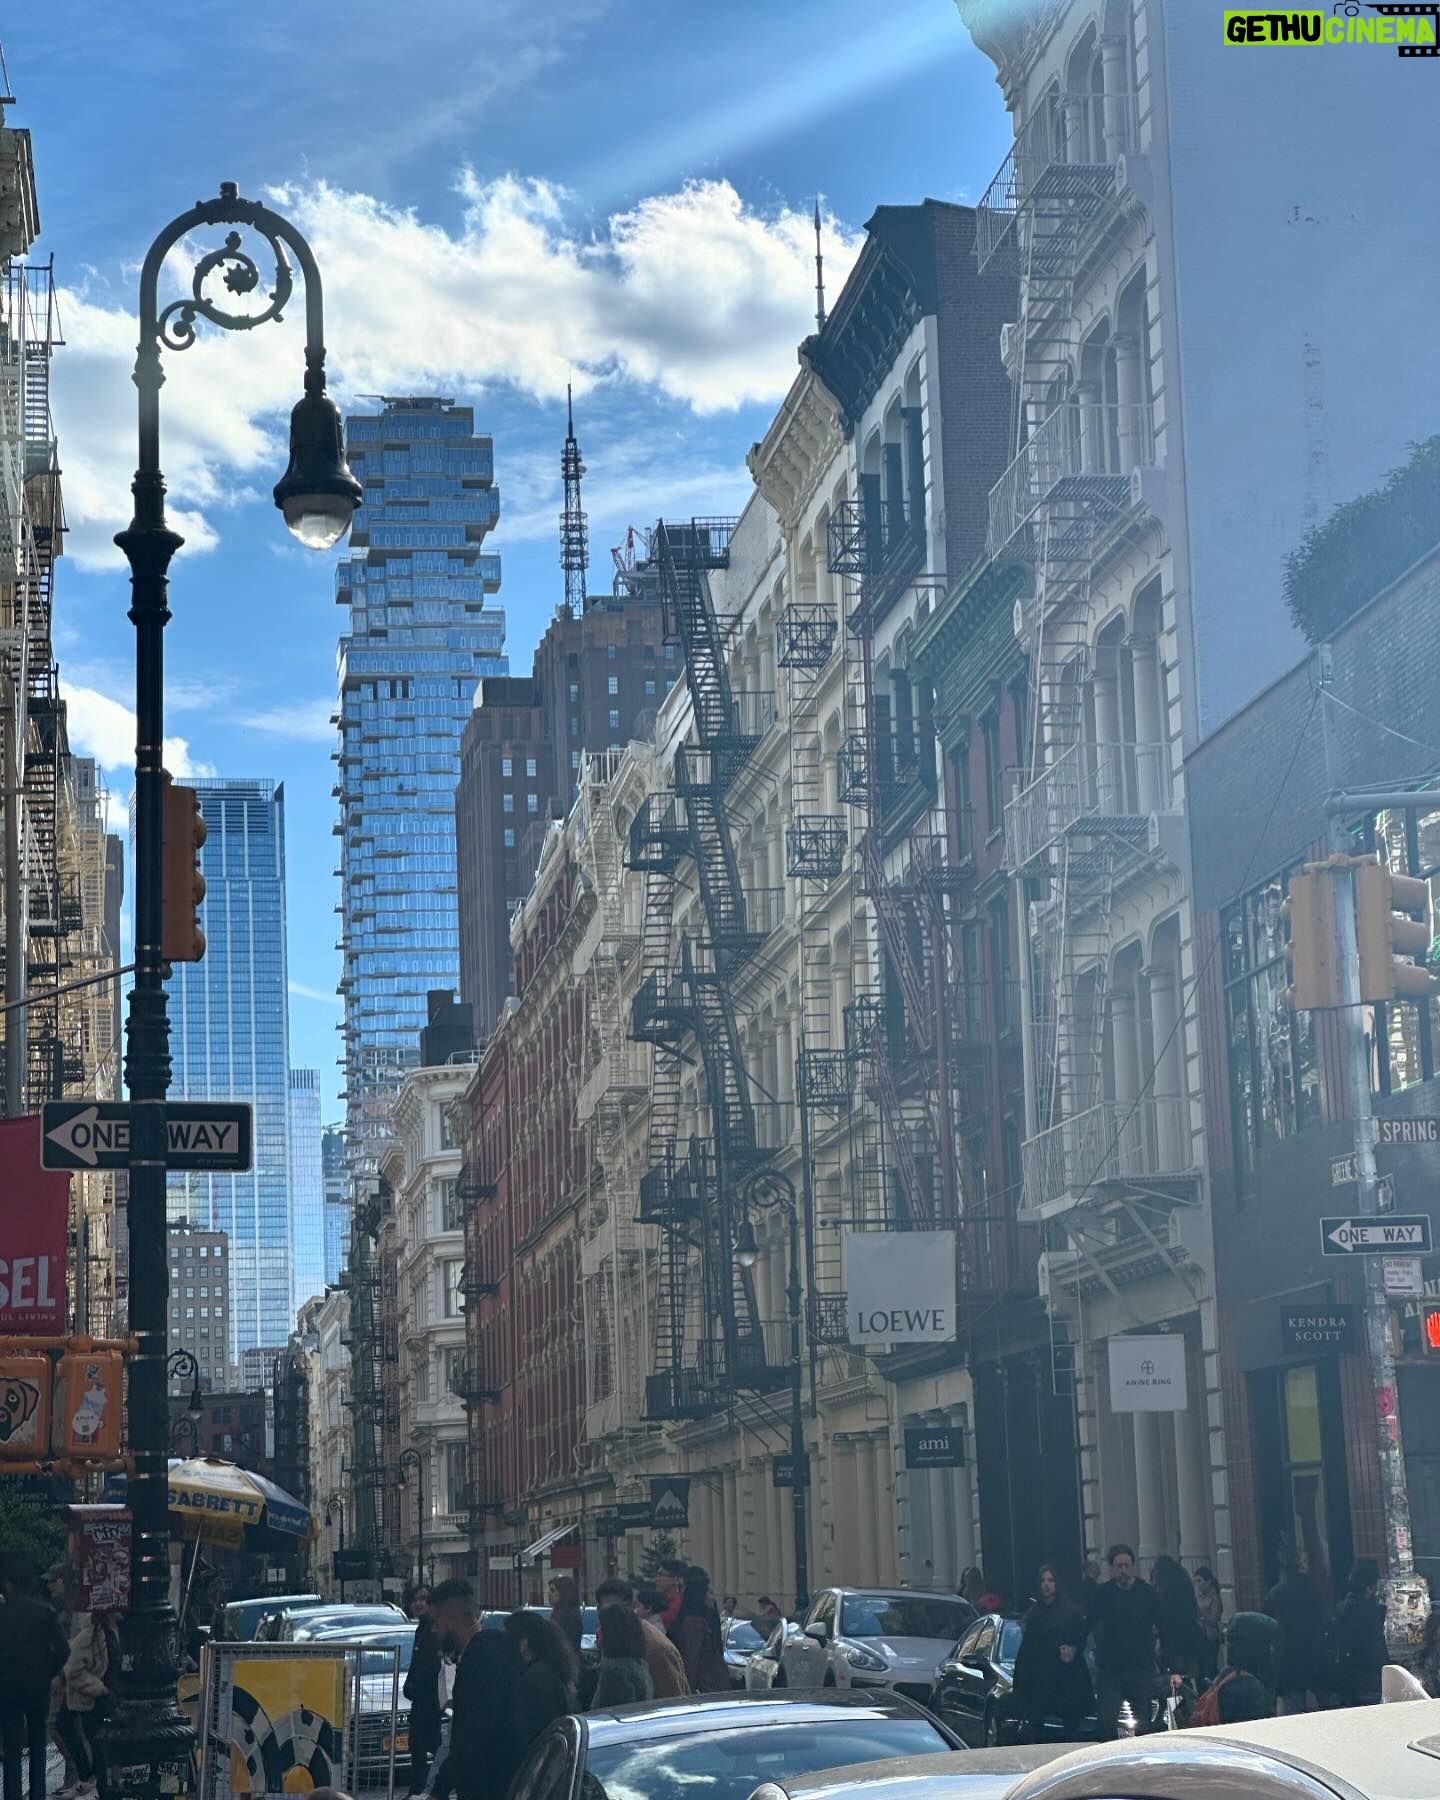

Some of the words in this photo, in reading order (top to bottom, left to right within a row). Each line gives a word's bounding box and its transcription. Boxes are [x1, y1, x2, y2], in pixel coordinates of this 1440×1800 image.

[70, 1123, 130, 1149] ONE
[167, 1123, 232, 1149] WAY
[1383, 1120, 1438, 1142] SPRING
[1338, 1228, 1370, 1244] ONE
[1383, 1226, 1417, 1242] WAY
[18, 1312, 57, 1321] LIVING
[858, 1309, 945, 1334] LOEWE
[1288, 1316, 1347, 1329] KENDRA
[1295, 1331, 1343, 1342] SCOTT
[918, 1435, 949, 1450] ami
[168, 1488, 258, 1516] SABRETT
